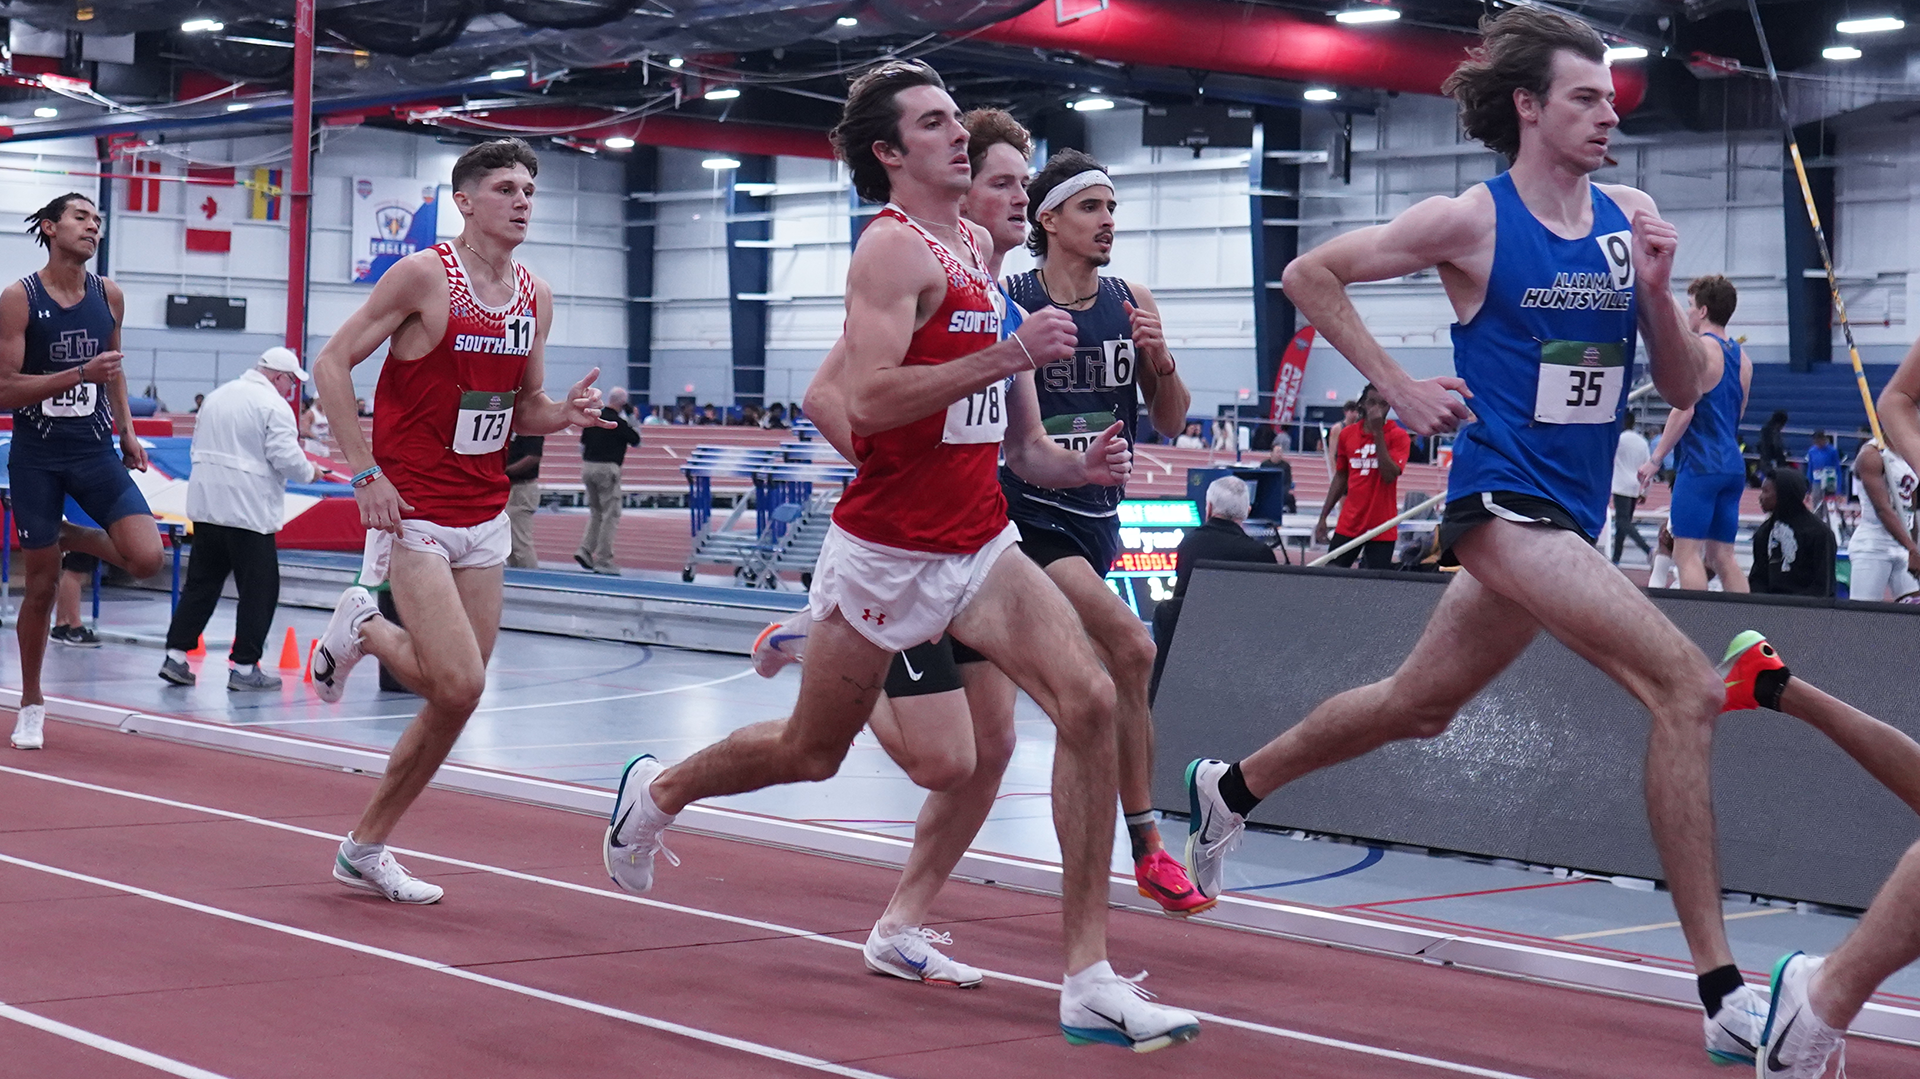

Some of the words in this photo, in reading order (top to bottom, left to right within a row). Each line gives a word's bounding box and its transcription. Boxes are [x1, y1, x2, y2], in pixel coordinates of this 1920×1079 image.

[1607, 235, 1631, 286] 9
[1551, 271, 1615, 291] ALABAMA
[1520, 287, 1633, 311] HUNTSVILLE
[49, 329, 99, 362] STU
[453, 333, 530, 357] SOUTH
[508, 318, 530, 349] 11
[1114, 342, 1131, 384] 6
[1565, 370, 1605, 407] 35
[964, 386, 1000, 426] 178
[471, 412, 507, 442] 173
